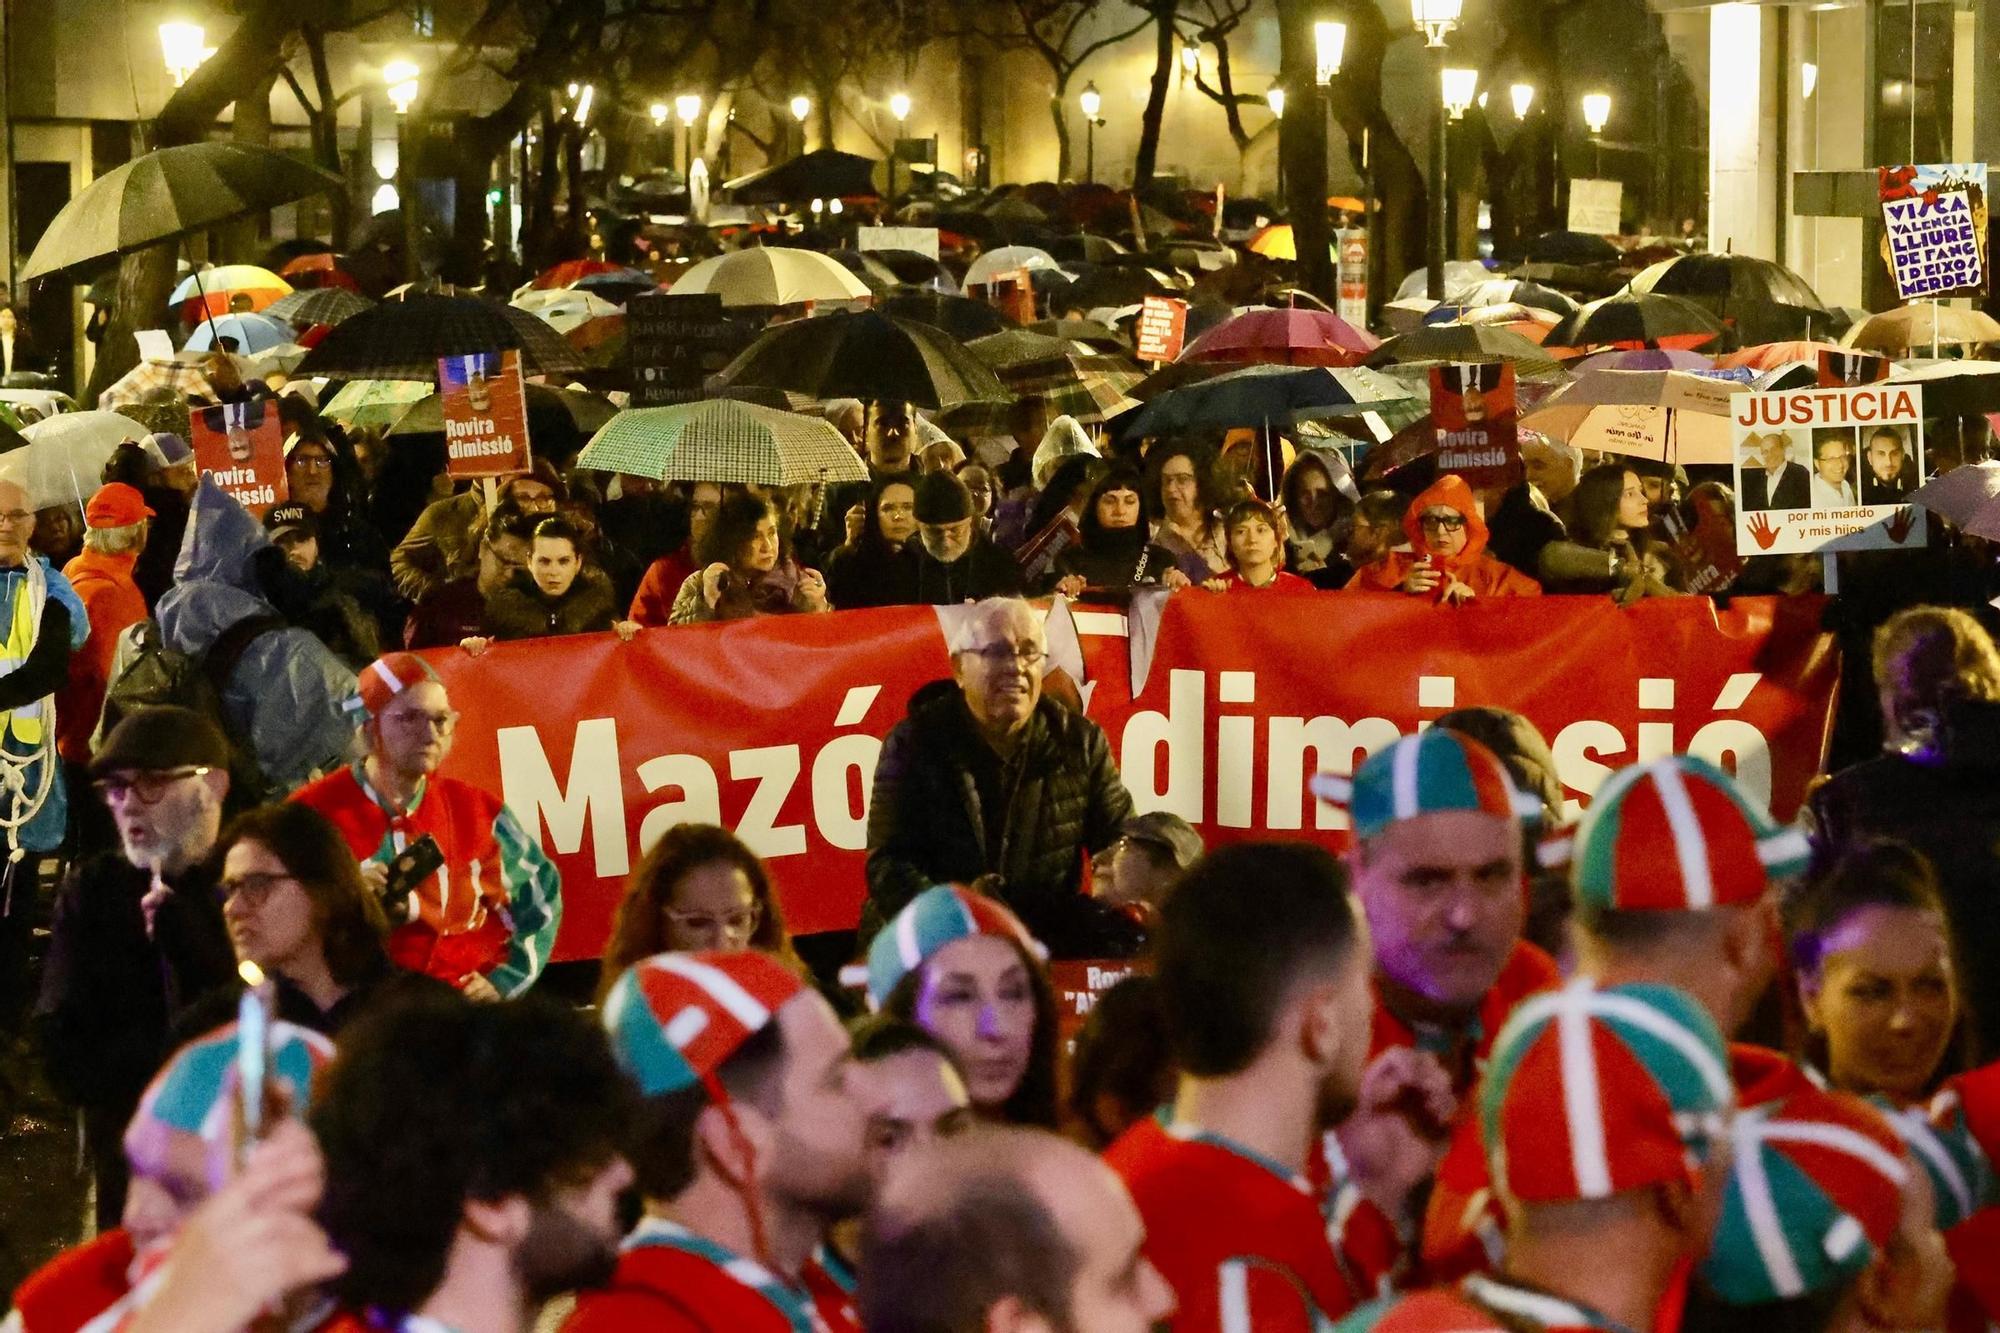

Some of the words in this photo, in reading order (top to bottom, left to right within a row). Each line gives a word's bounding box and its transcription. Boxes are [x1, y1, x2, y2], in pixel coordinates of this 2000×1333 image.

[1887, 196, 1967, 221] VISCA
[1891, 214, 1969, 235] VALENCIA
[1893, 225, 1973, 252] LLIURE
[1896, 252, 1921, 267] DE
[1899, 270, 1905, 281] I
[1901, 270, 1979, 296] MERDES
[1738, 391, 1917, 427] JUSTICIA
[445, 417, 495, 437] Rovira
[1437, 428, 1488, 447] Rovira
[449, 435, 513, 459] dimissió
[1438, 447, 1506, 469] dimissió
[274, 507, 303, 522] SWAT
[1788, 512, 1809, 523] por
[1813, 511, 1827, 520] mi
[1831, 508, 1875, 519] marido
[1799, 528, 1806, 538] y
[1810, 526, 1831, 536] mis
[1835, 523, 1864, 536] hijos
[1134, 552, 1149, 581] adidas
[1686, 564, 1720, 594] ovira
[497, 685, 882, 877] Mazó
[1121, 669, 1772, 830] dimsió
